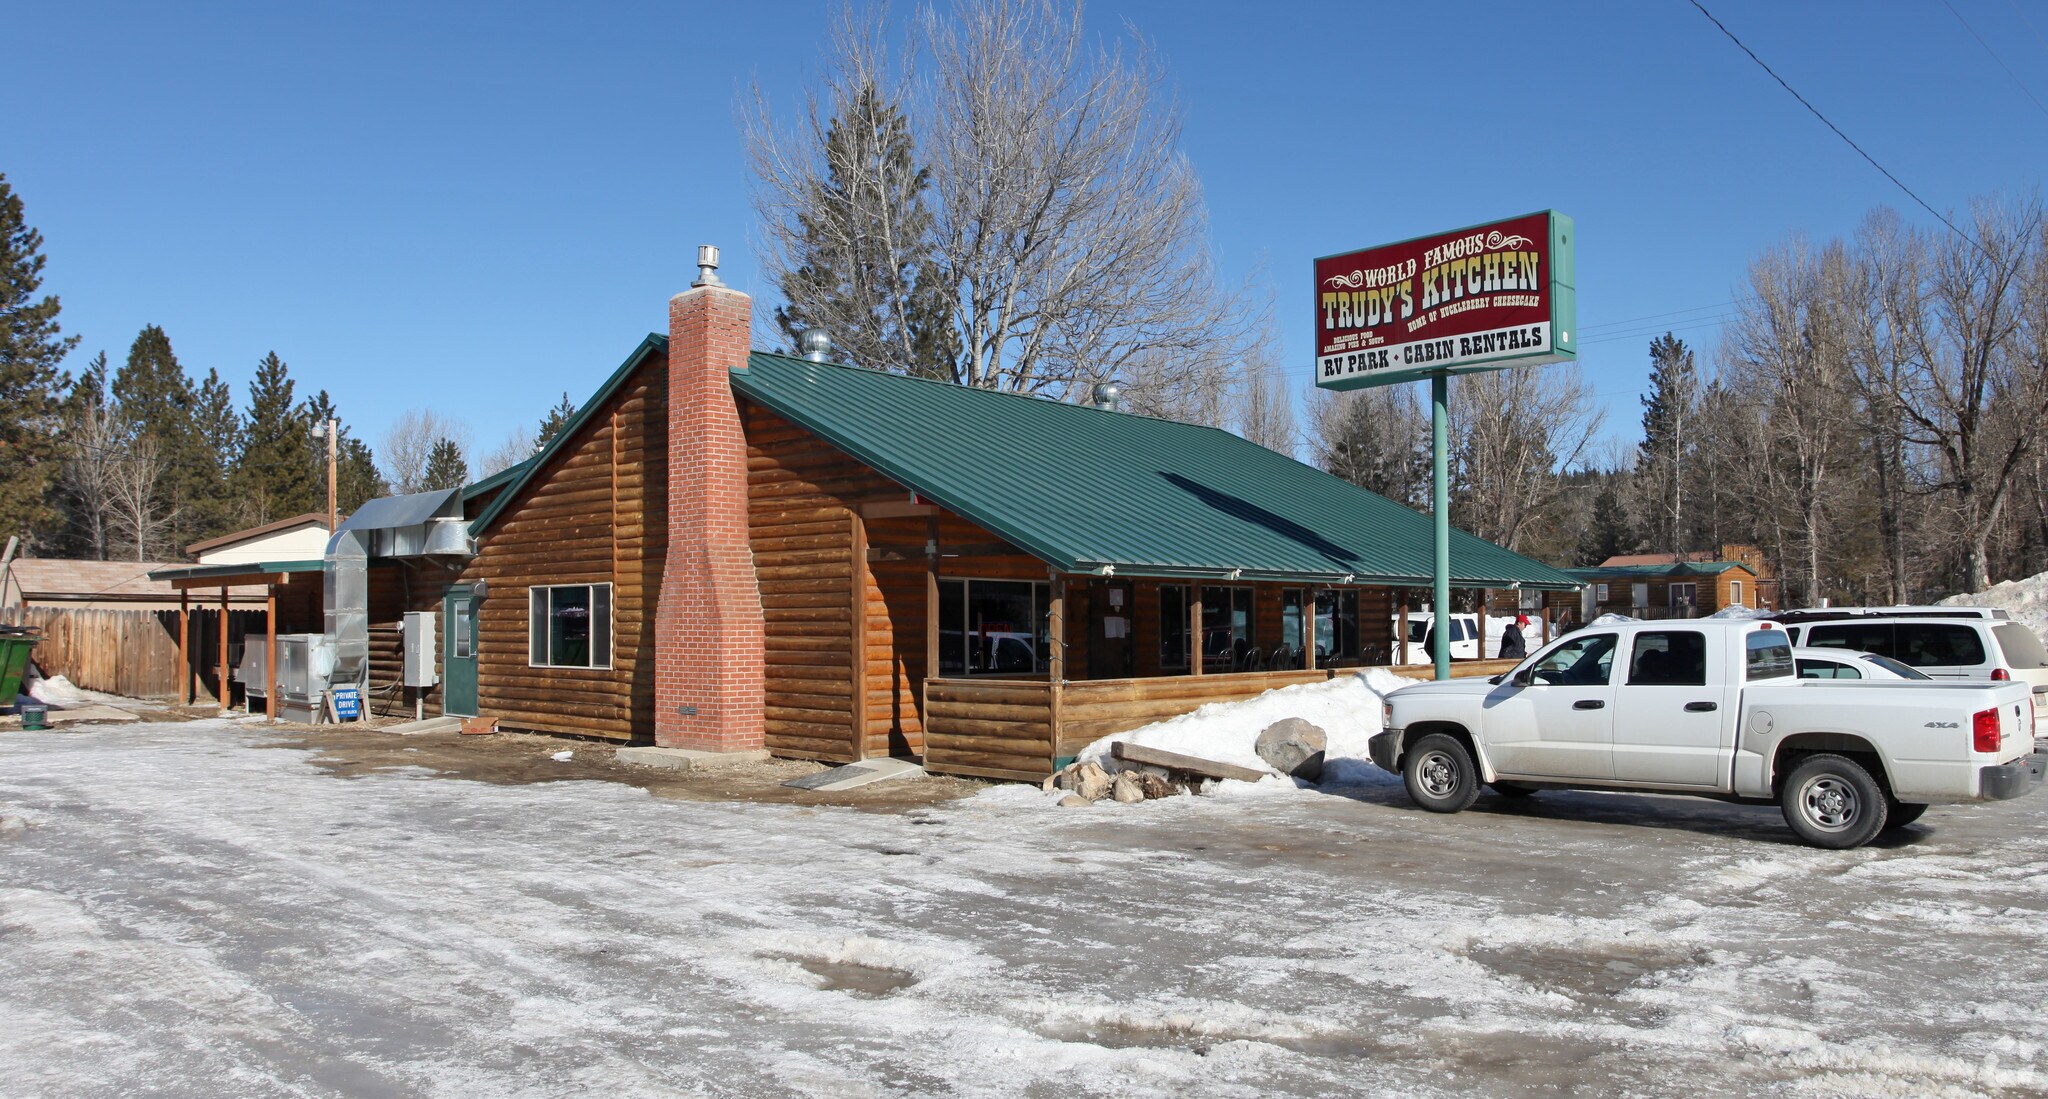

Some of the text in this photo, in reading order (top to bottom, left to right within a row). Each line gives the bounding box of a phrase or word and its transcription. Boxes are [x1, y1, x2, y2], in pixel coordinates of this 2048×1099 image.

[1364, 233, 1485, 288] WORLD FAMOUS
[1322, 251, 1539, 330] TRUDY'S KITCHEN
[1407, 295, 1540, 333] HOME OF HUCKLEBERRY CHEESECAKE
[1323, 336, 1385, 353] AMAZING PIES & SOUPS
[1324, 327, 1542, 376] RV PARK CABIN RENTALS
[1333, 331, 1373, 344] DELICIOUS FOOD
[336, 692, 357, 700] PRIVATE
